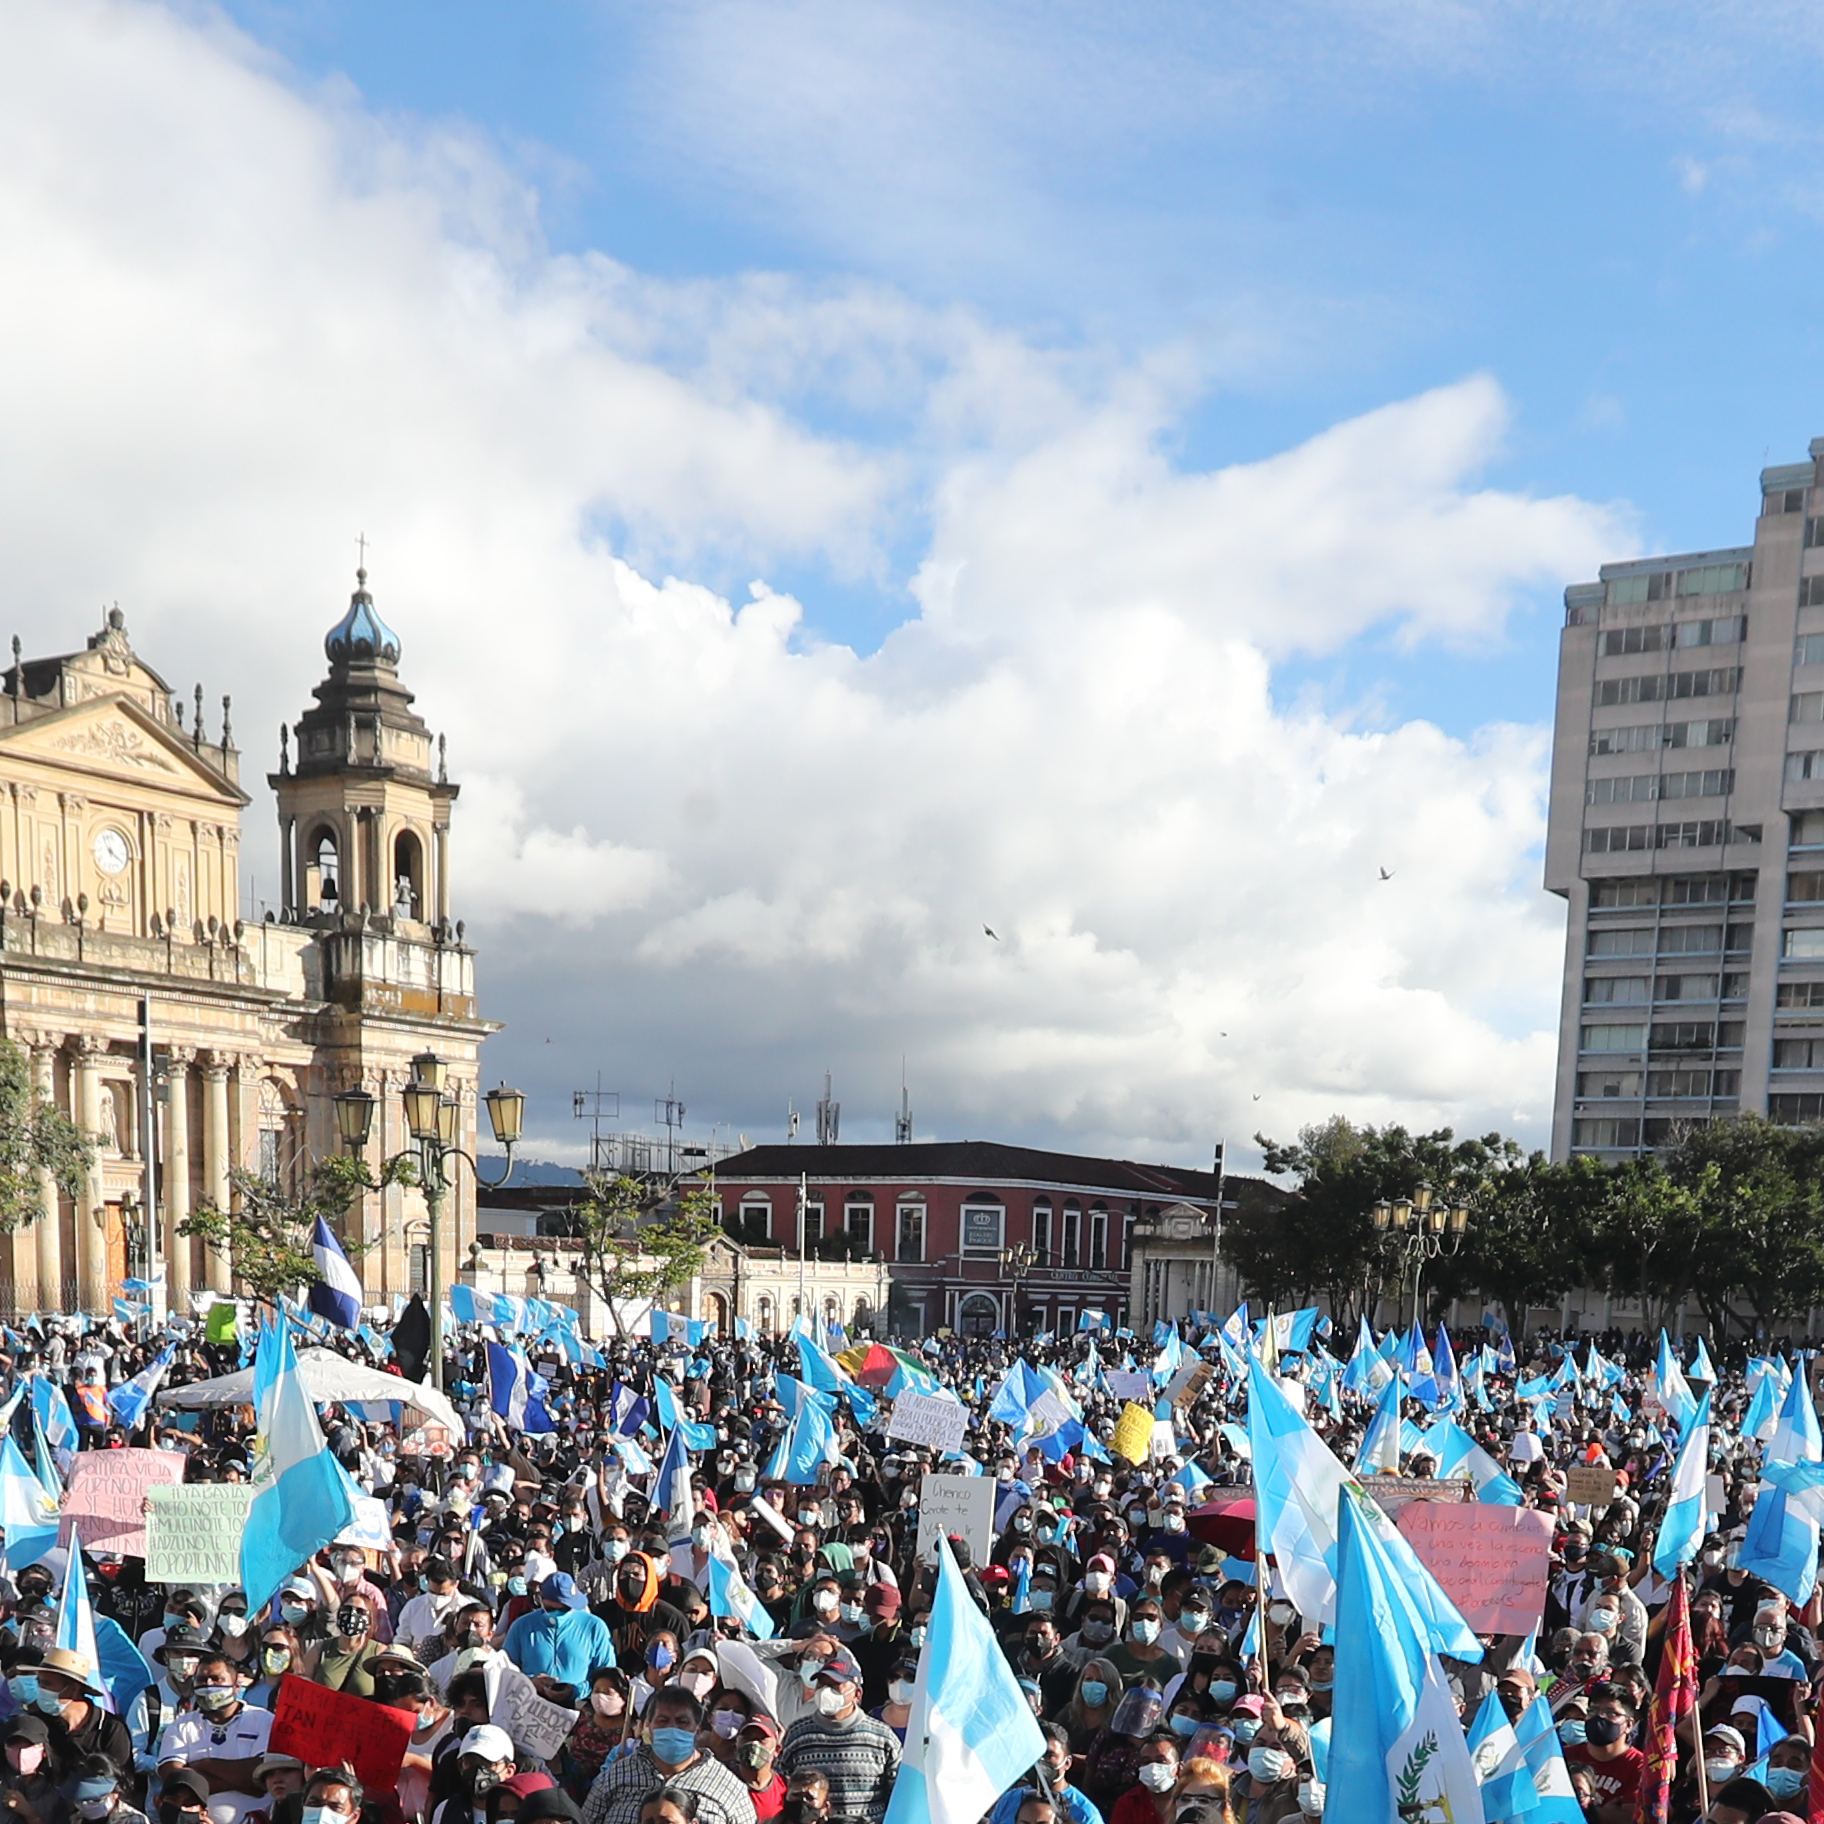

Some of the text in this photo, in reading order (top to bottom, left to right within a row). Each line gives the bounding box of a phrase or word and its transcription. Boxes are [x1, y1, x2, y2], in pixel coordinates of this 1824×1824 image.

[94, 1451, 117, 1463] NO
[1402, 1507, 1465, 1531] Vamos
[1429, 1539, 1454, 1550] una
[283, 1703, 316, 1729] TAN
